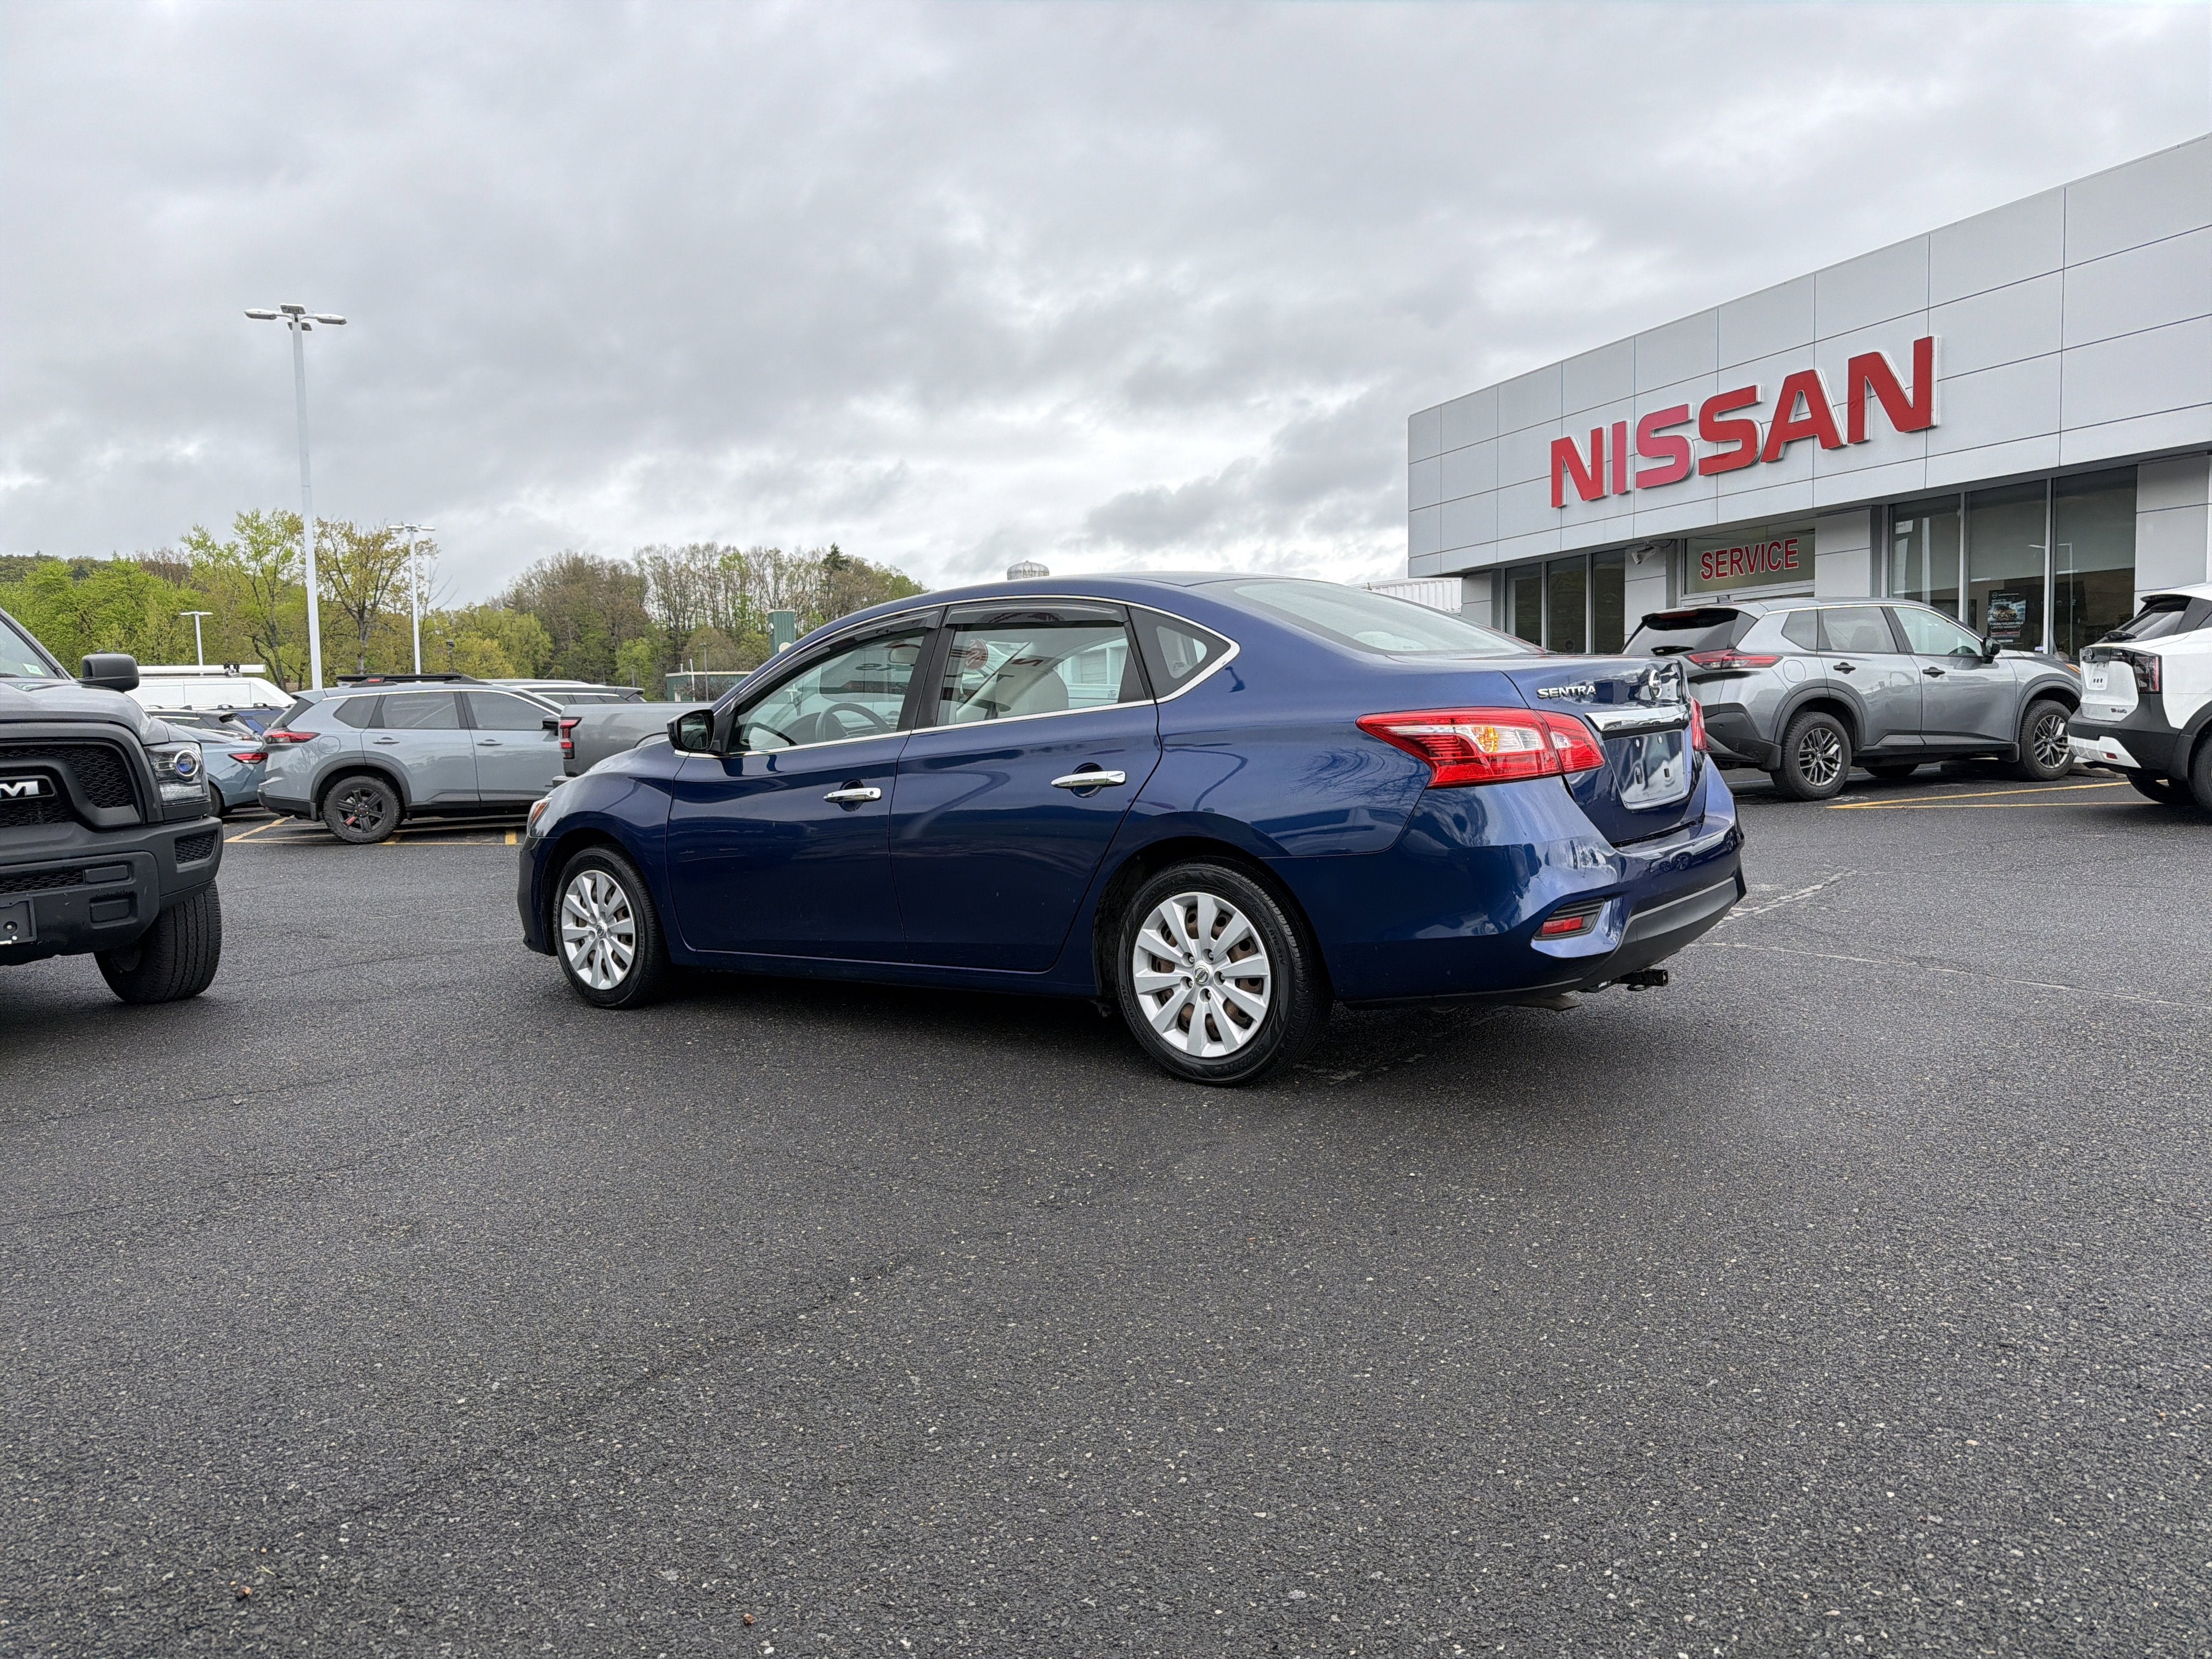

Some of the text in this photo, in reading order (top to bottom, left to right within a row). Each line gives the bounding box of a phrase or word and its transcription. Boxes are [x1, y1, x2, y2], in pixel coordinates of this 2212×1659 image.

[1551, 336, 1936, 508] NISSAN
[1700, 538, 1799, 580] SERVICE
[1537, 685, 1596, 698] SENTRA
